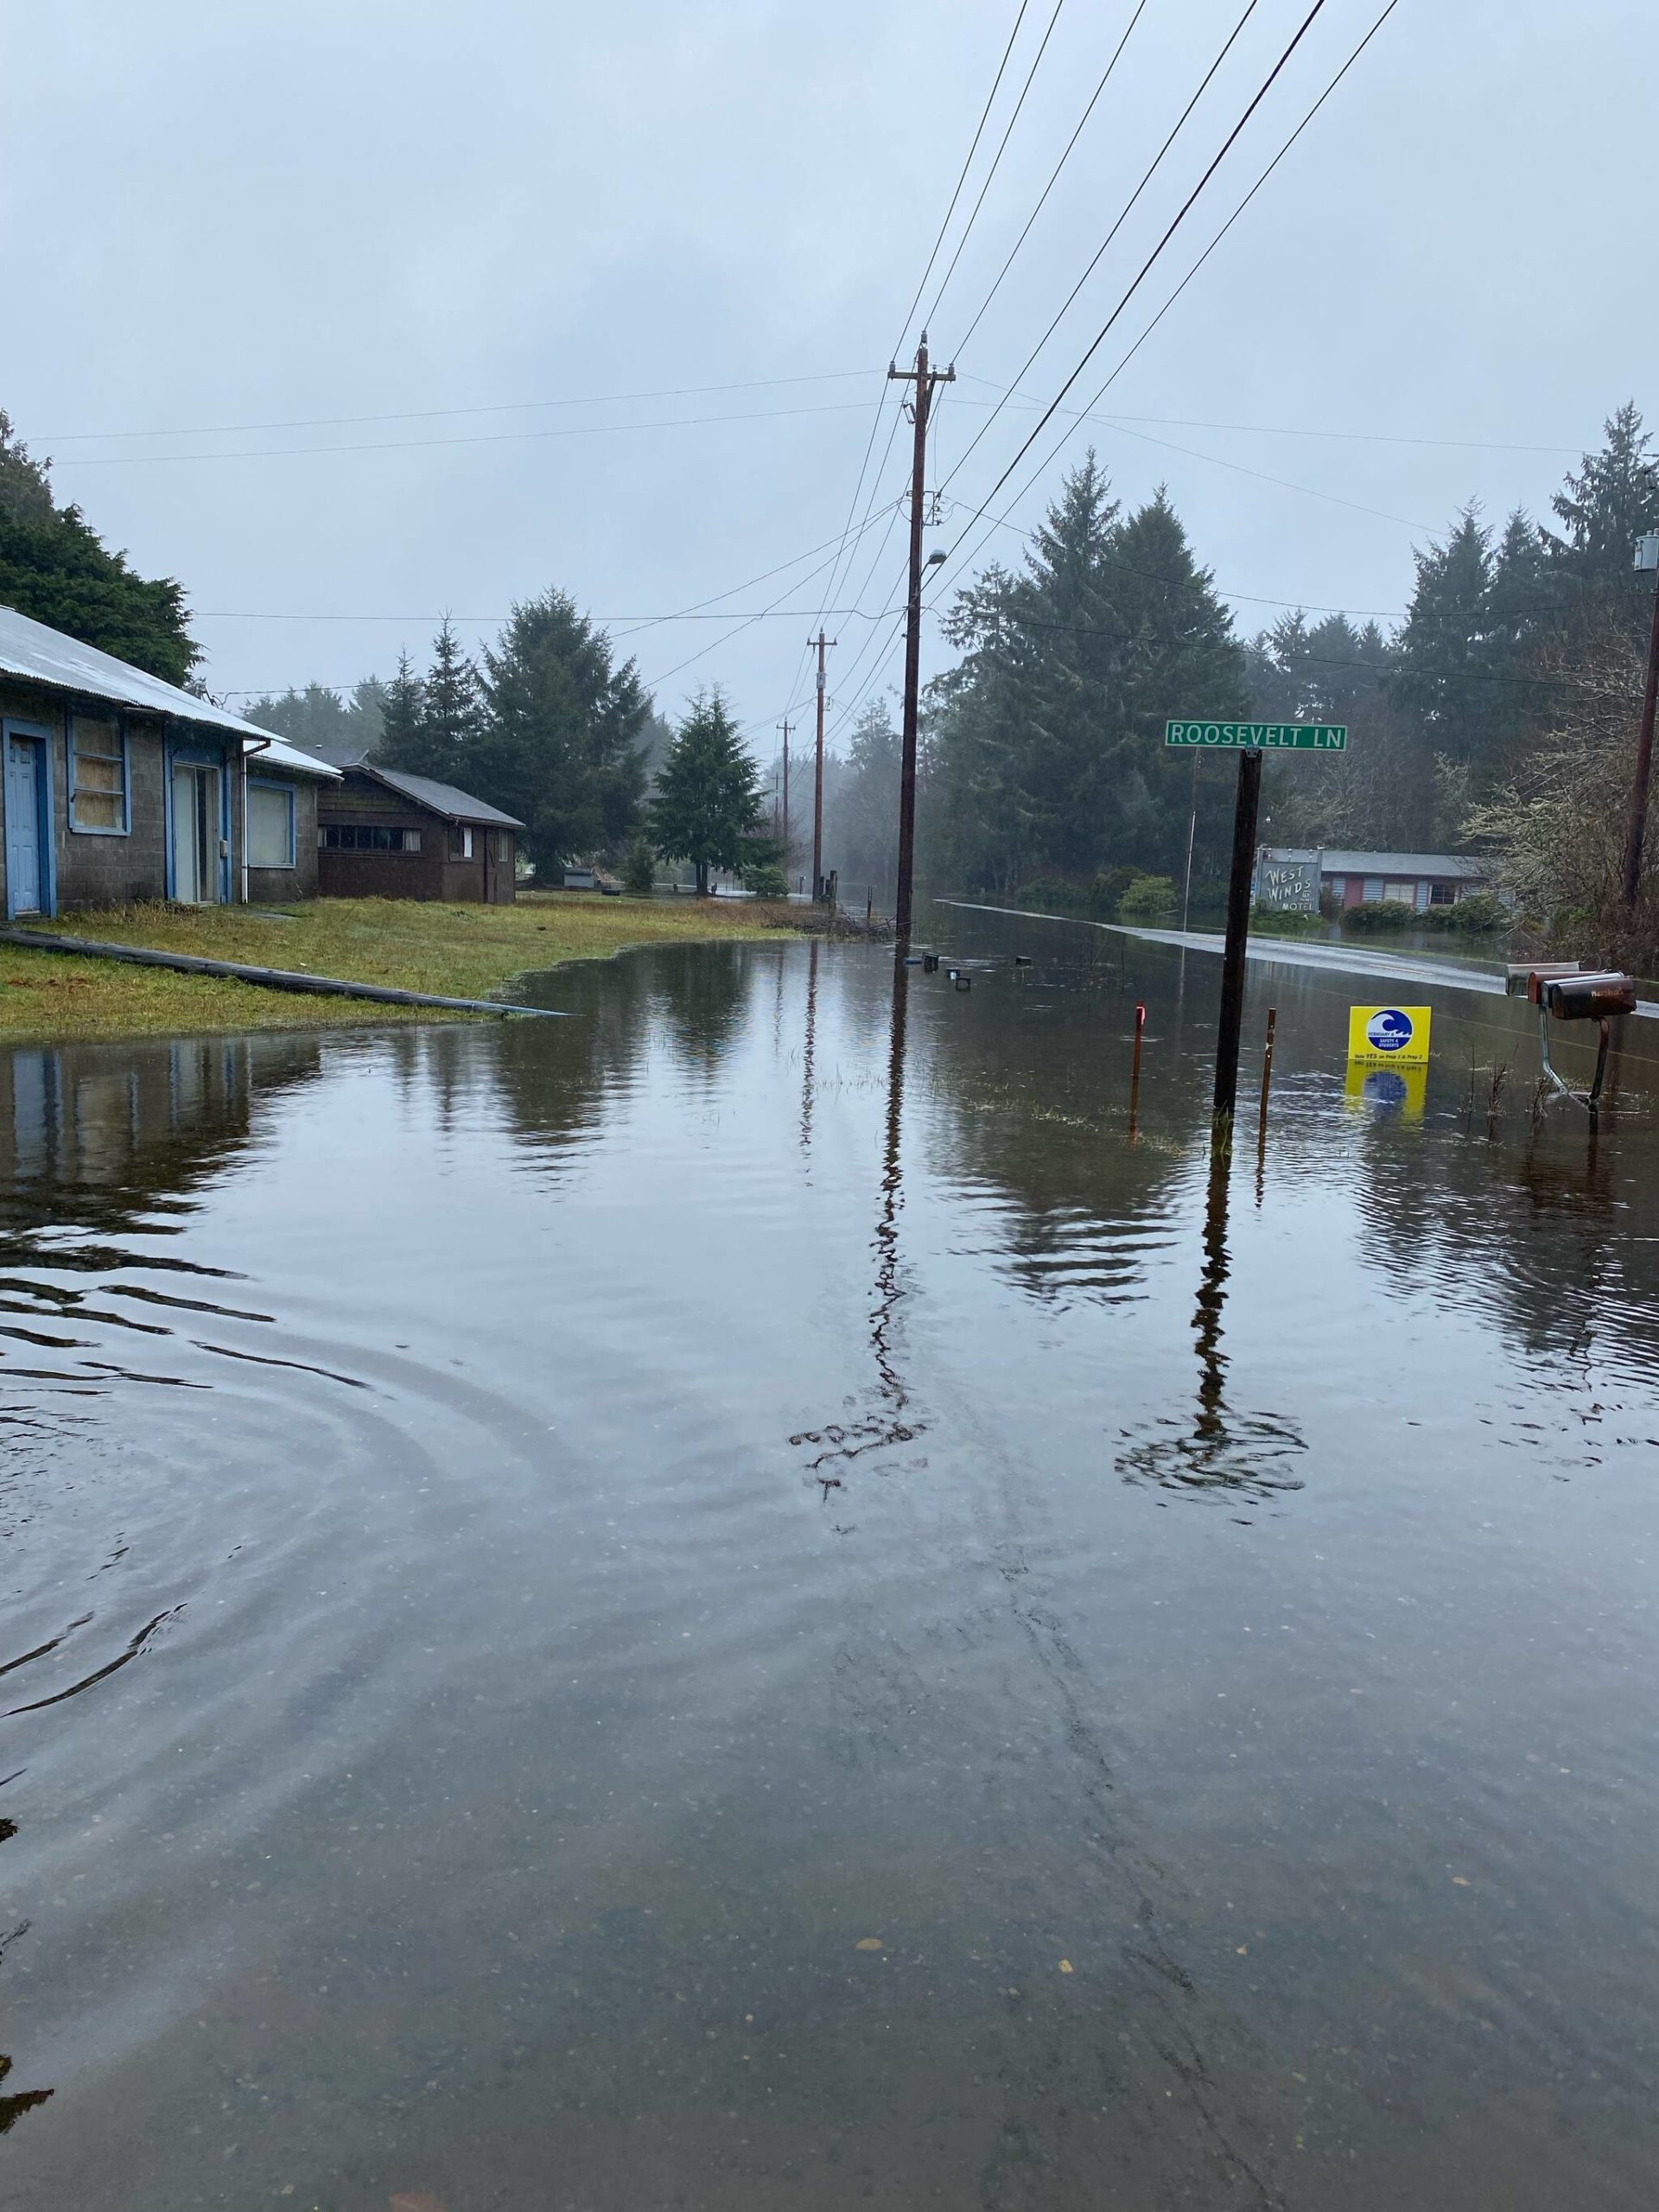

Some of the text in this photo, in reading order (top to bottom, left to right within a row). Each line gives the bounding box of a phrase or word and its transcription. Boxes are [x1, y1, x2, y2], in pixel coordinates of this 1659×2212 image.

[1171, 724, 1342, 747] ROOSEVELT LN
[1265, 866, 1304, 887] WEST
[1268, 878, 1311, 903] WINDS
